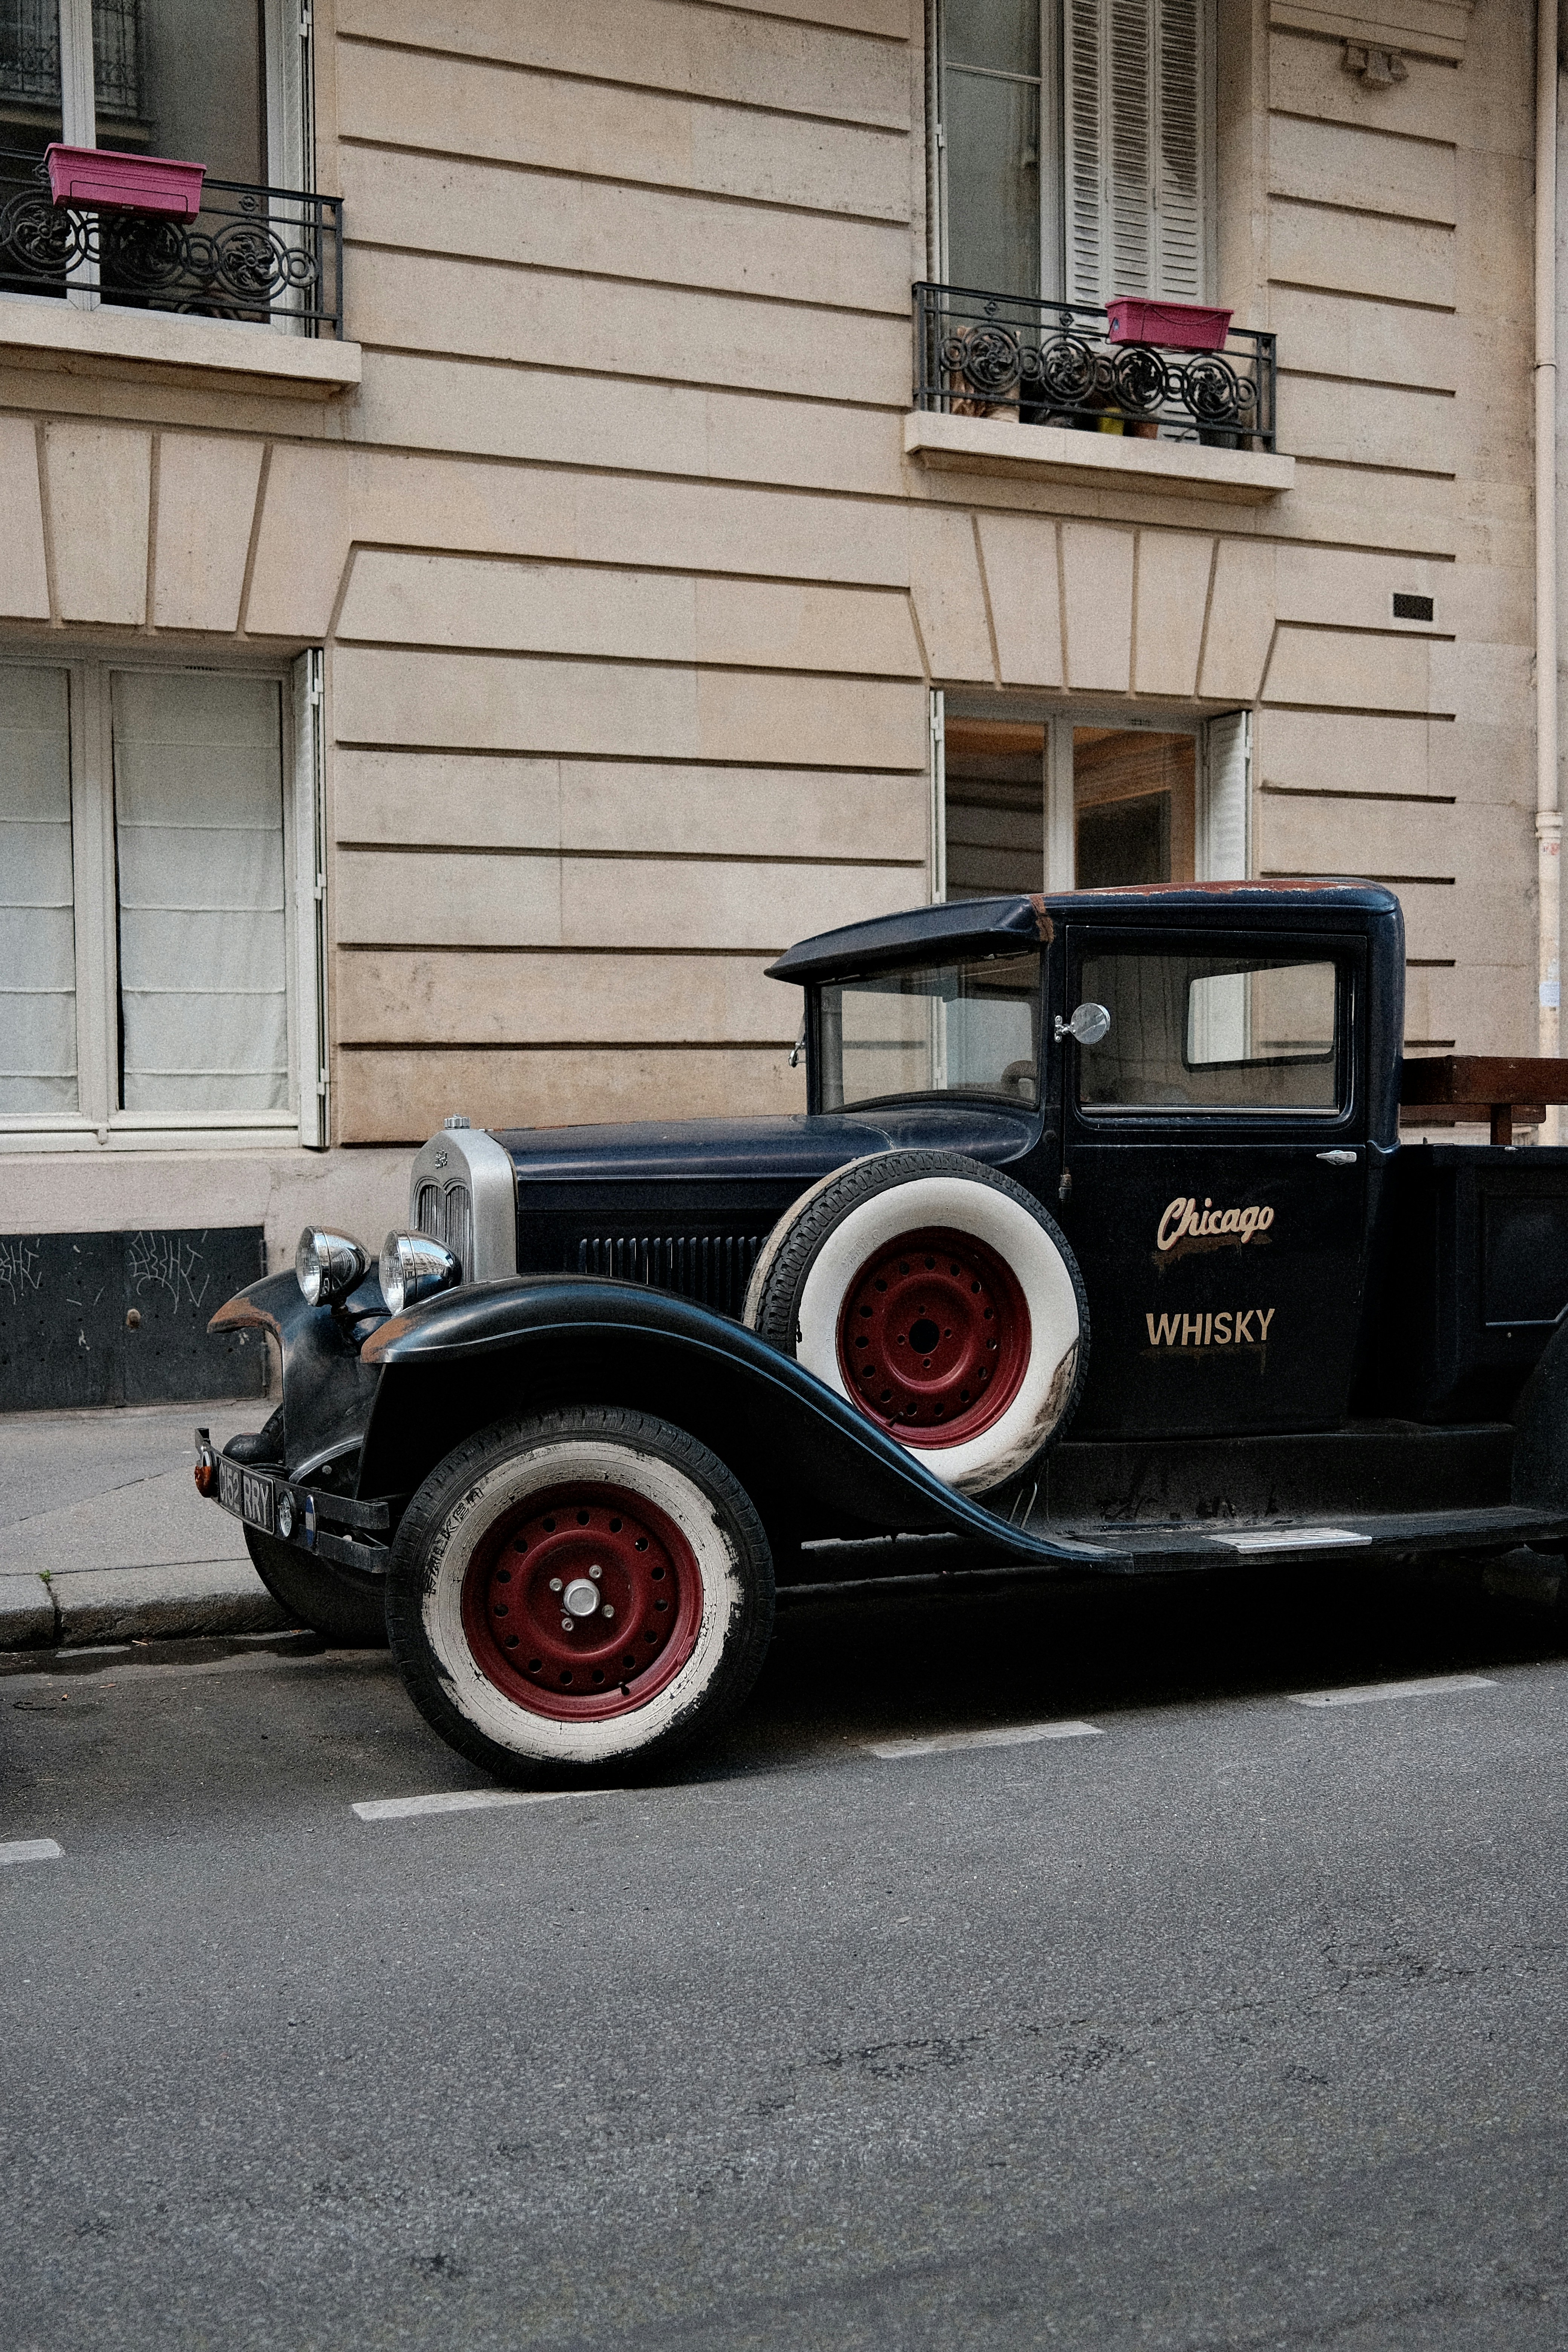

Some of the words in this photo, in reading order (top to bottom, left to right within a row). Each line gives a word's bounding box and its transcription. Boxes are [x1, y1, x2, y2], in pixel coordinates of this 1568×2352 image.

[1157, 1197, 1275, 1250] Chicago
[1145, 1308, 1275, 1345] WHISKY
[243, 1475, 269, 1525] RRY
